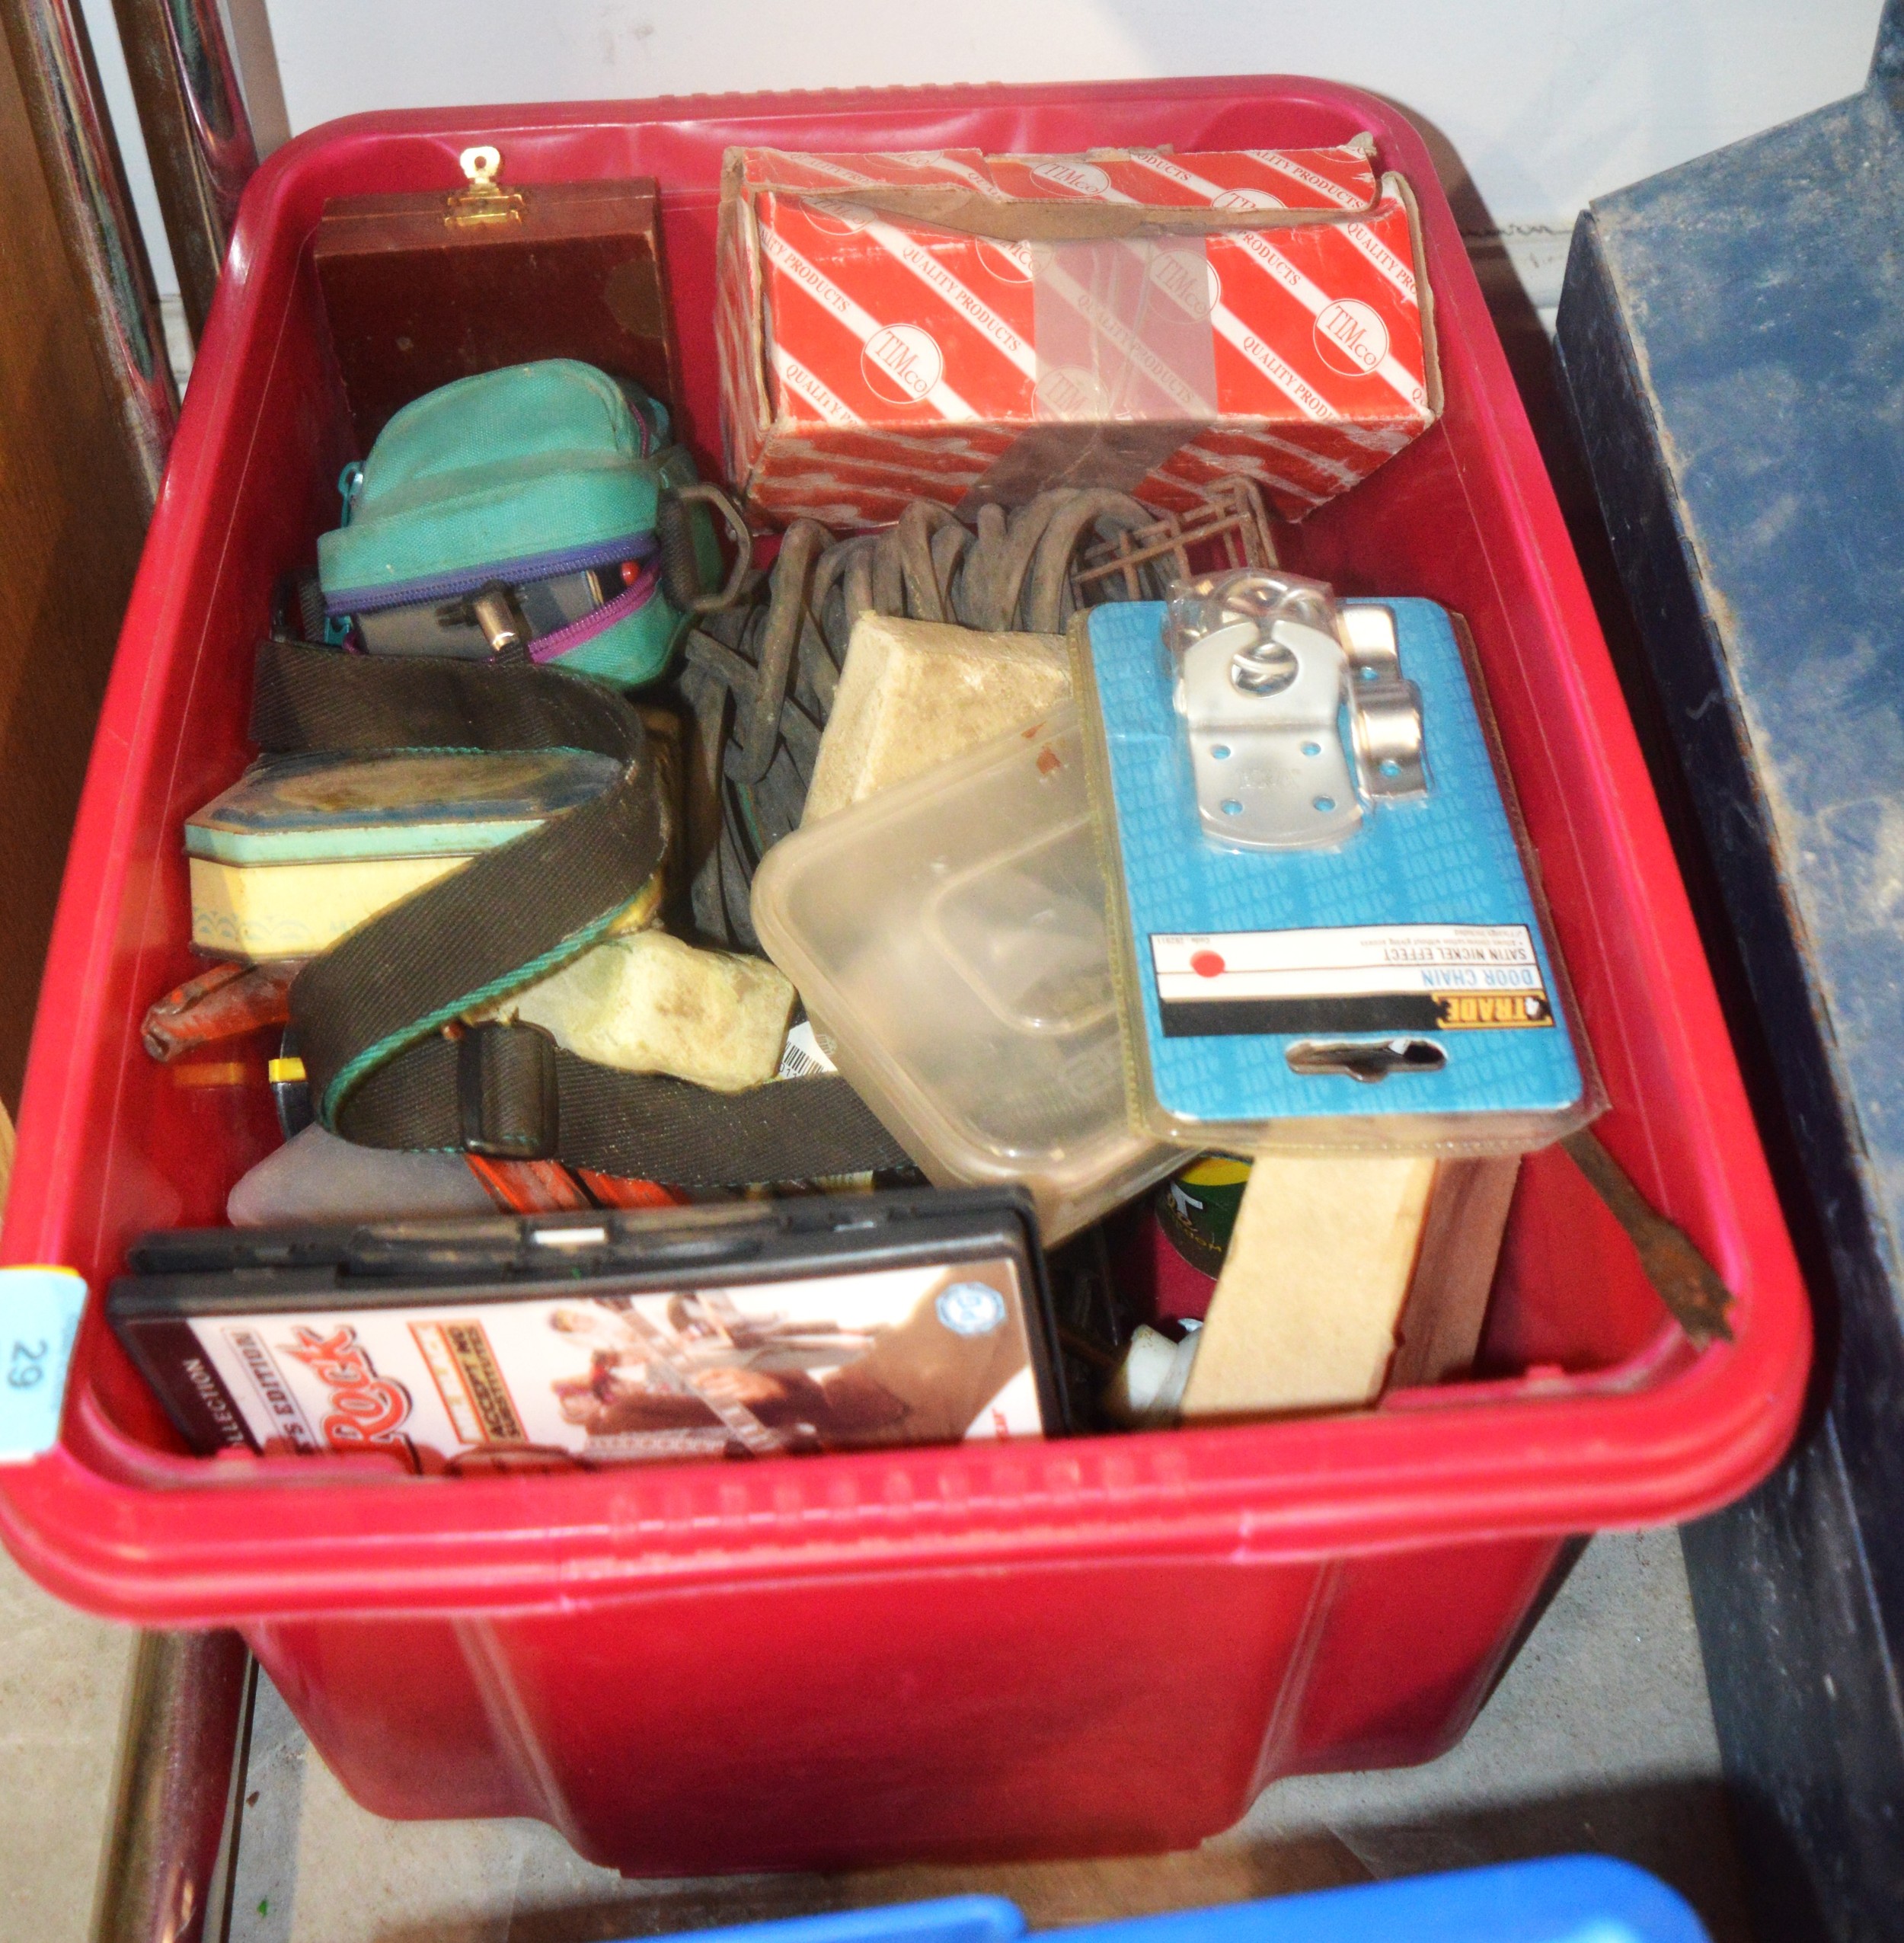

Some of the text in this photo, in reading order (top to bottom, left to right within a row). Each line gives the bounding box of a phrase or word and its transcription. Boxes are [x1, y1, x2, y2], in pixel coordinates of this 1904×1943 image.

[1292, 166, 1369, 208] PRODUCTS
[1347, 221, 1398, 276] QUALITY
[782, 253, 851, 313] PRODUCTS
[902, 242, 1022, 353] QUALITY PRODUCTS
[785, 364, 842, 415] QUALITY
[1243, 335, 1296, 390] QUALITY
[1384, 948, 1527, 962] SATIN NICKEL EFFECT
[1420, 968, 1534, 988] DOOR CHAIN
[7, 1339, 49, 1389] 29
[232, 1331, 295, 1415] EDITION
[184, 1359, 245, 1443] LLECTION
